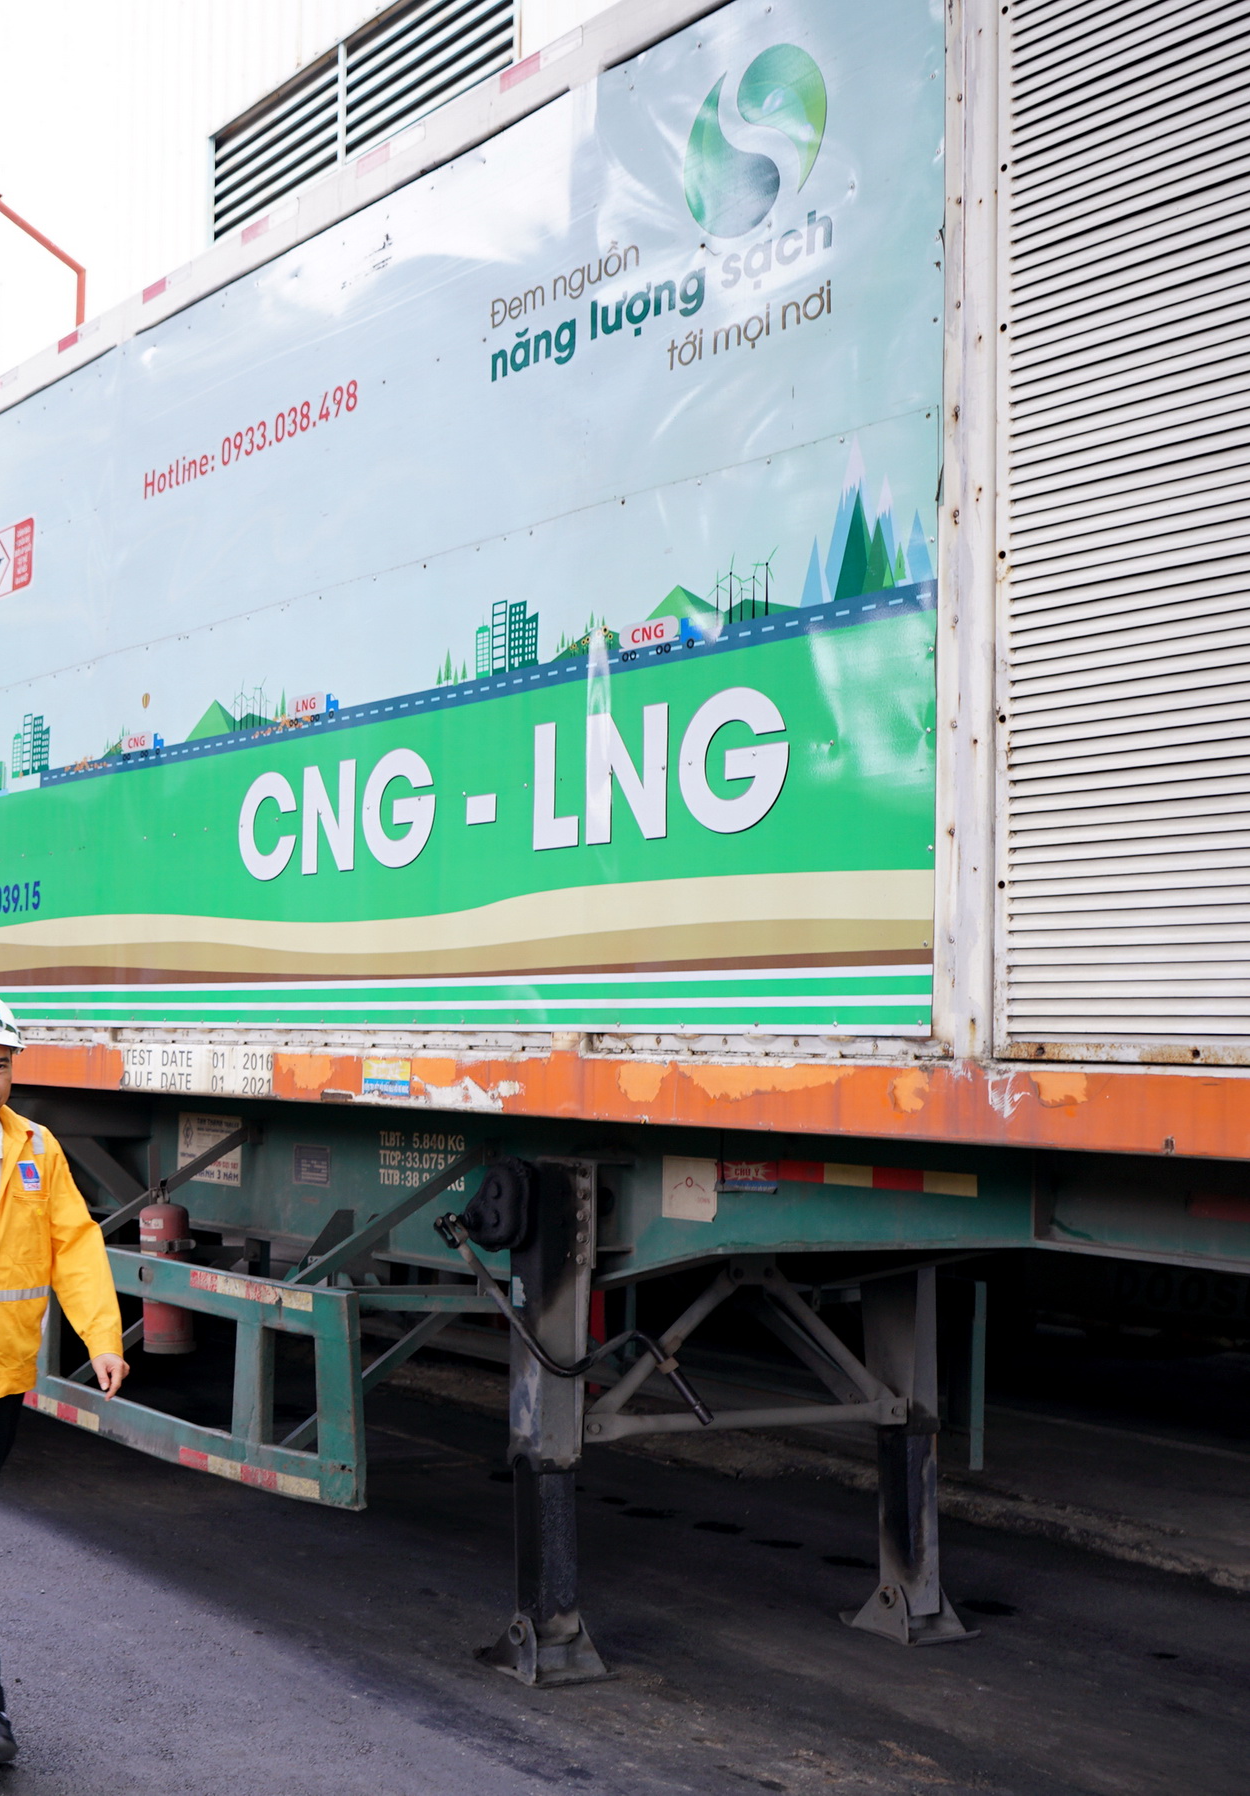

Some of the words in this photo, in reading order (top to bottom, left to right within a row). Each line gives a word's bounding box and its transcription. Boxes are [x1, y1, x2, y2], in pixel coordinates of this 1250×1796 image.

[490, 285, 546, 328] Đem
[553, 240, 640, 302] nguồn
[490, 316, 577, 382] năng
[590, 267, 706, 340] lượng
[720, 210, 833, 289] sạch
[667, 328, 705, 371] tới
[712, 302, 771, 356] mọi
[781, 280, 833, 331] nơi
[144, 453, 216, 500] Hotline:
[221, 379, 359, 468] 0933.038.498
[631, 623, 665, 643] CNG
[295, 697, 316, 713] LNG
[127, 735, 146, 750] CNG
[238, 747, 437, 882] CNG
[533, 686, 790, 852] LNG
[124, 1049, 152, 1067] TEST
[161, 1050, 193, 1068] DATE
[212, 1052, 225, 1070] 01
[242, 1053, 273, 1072] 2016
[160, 1072, 192, 1091] DATE
[211, 1075, 225, 1093] 01
[242, 1076, 273, 1095] 2021
[412, 1133, 445, 1150] 5.840
[448, 1135, 465, 1151] KG
[217, 1169, 221, 1179] 3
